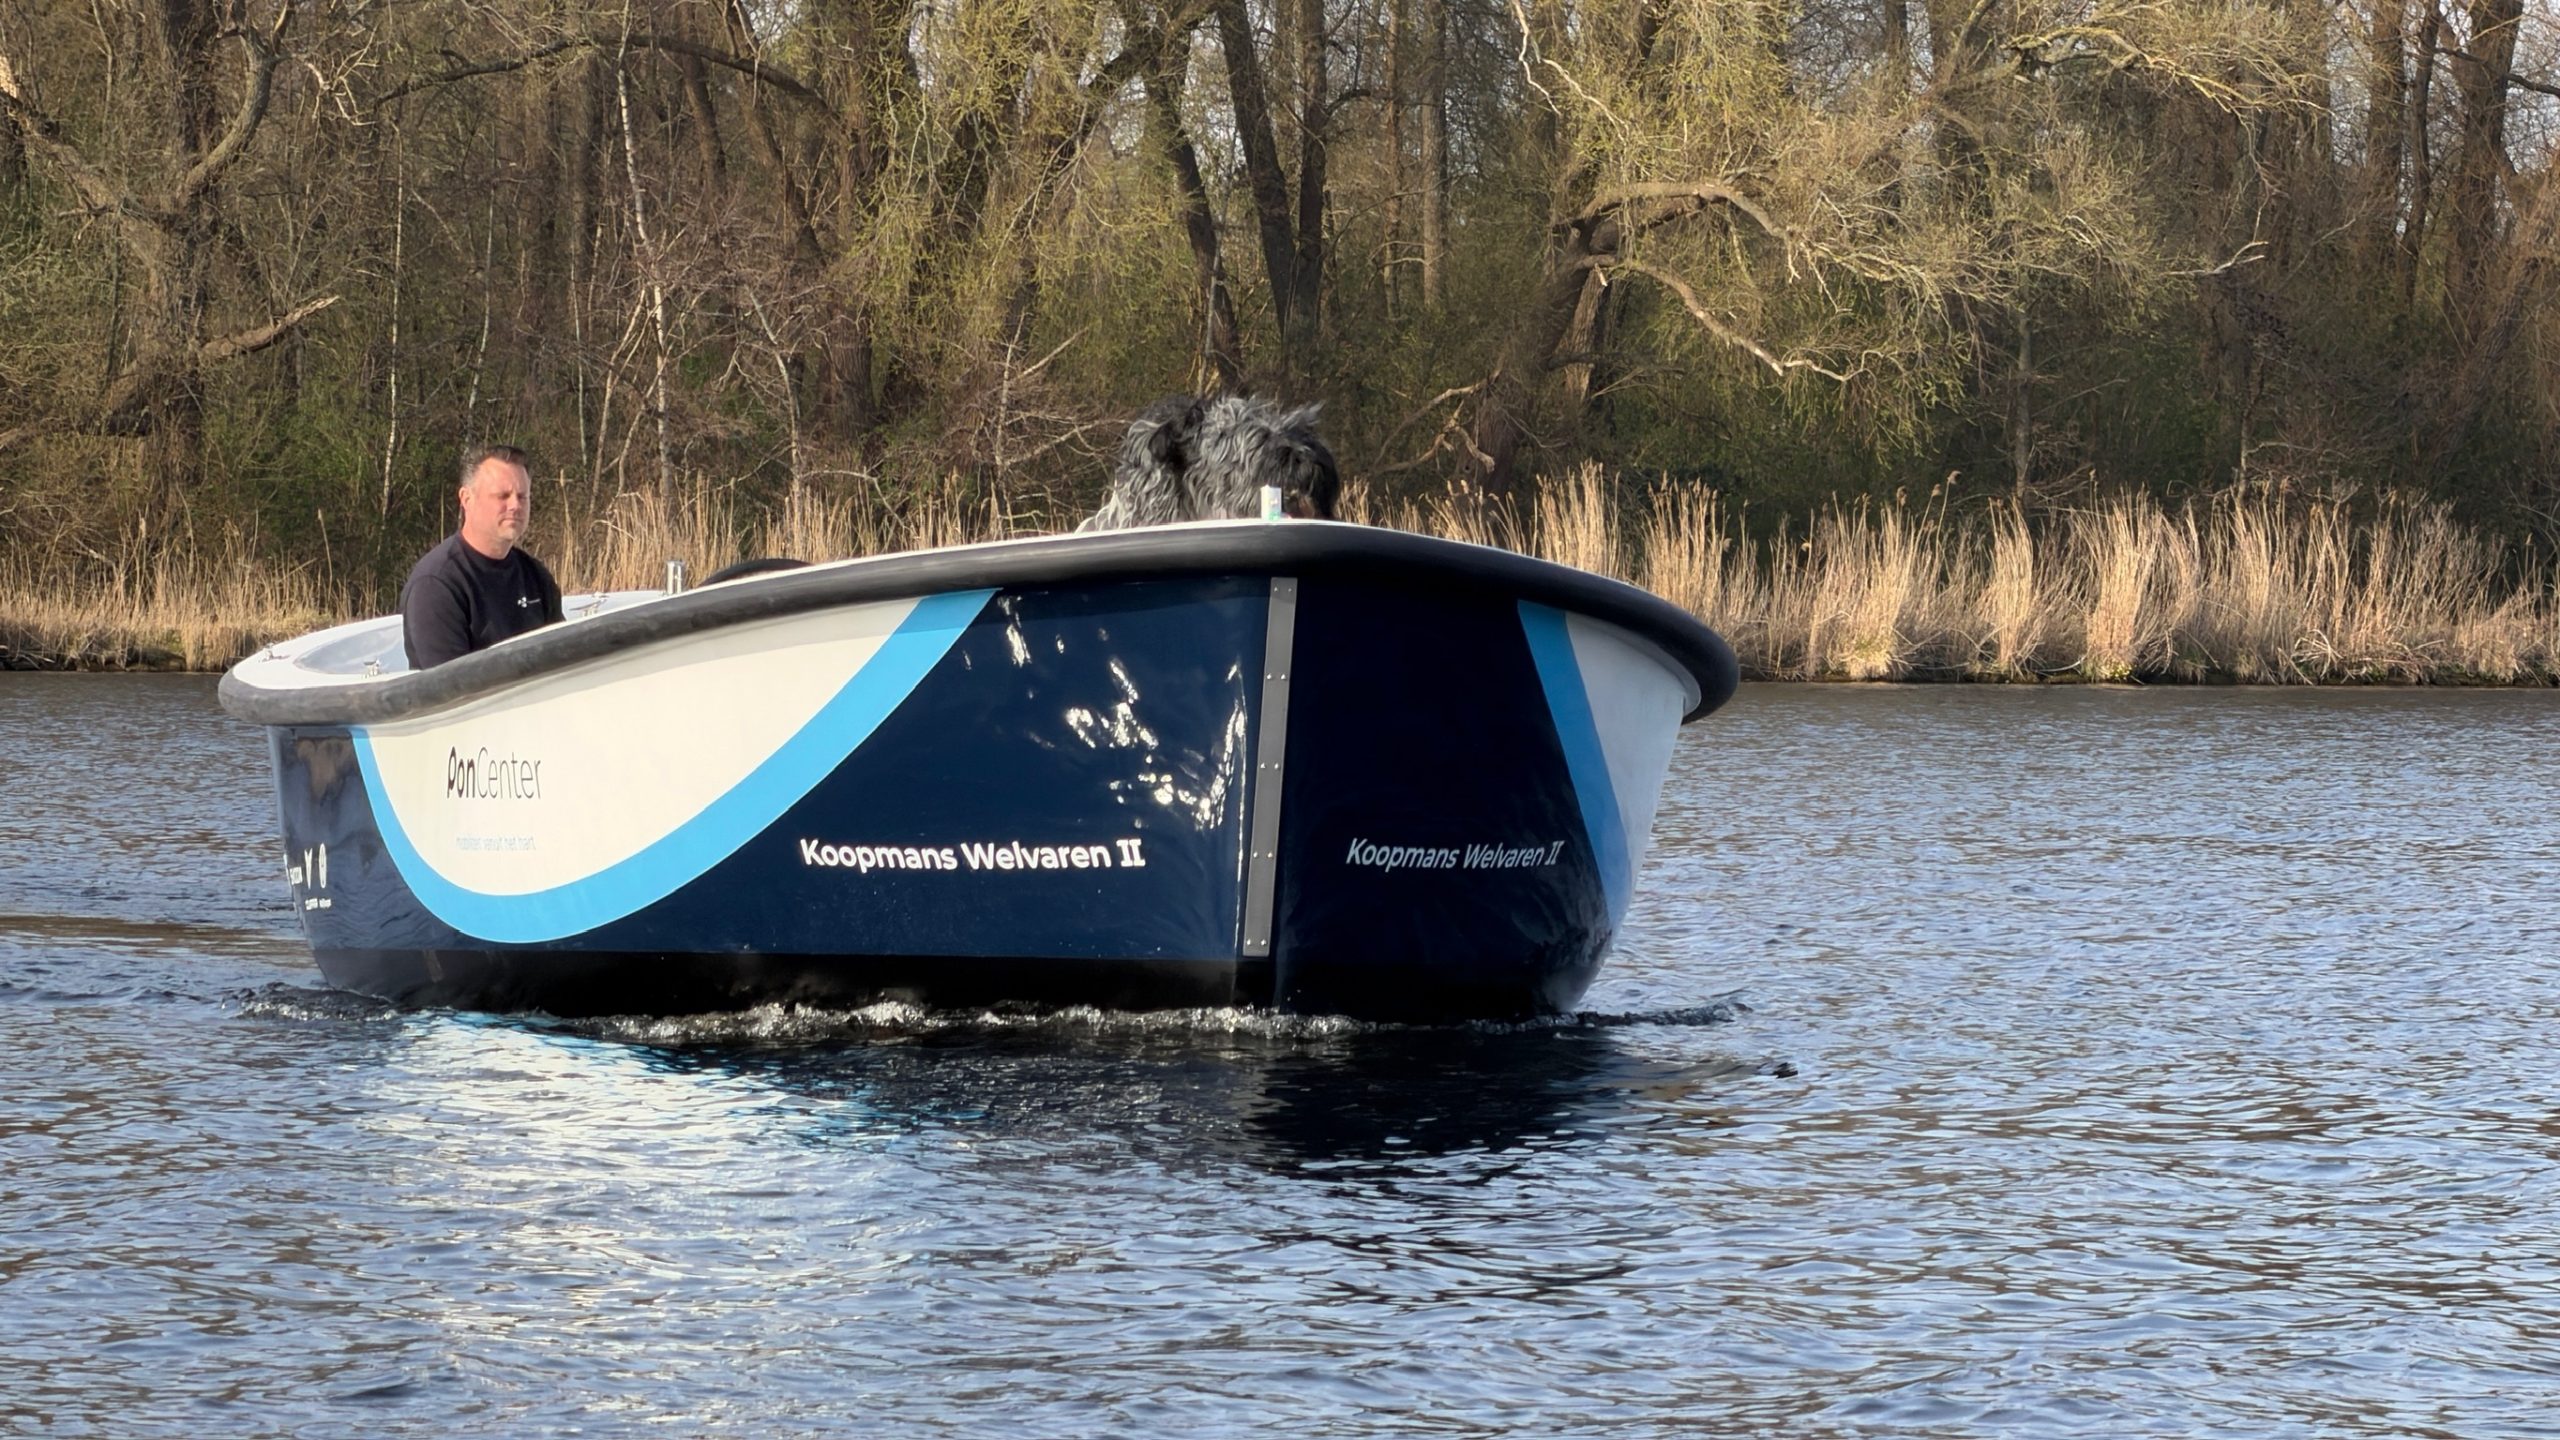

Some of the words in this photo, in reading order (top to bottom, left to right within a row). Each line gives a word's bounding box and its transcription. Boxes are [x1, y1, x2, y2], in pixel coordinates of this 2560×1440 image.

[446, 745, 542, 800] PonCenter
[799, 838, 958, 874] Koopmans
[960, 840, 1112, 871] Welvaren
[1115, 837, 1146, 868] II
[1345, 837, 1460, 873] Koopmans
[1462, 841, 1546, 870] Welvaren
[1544, 839, 1565, 867] II
